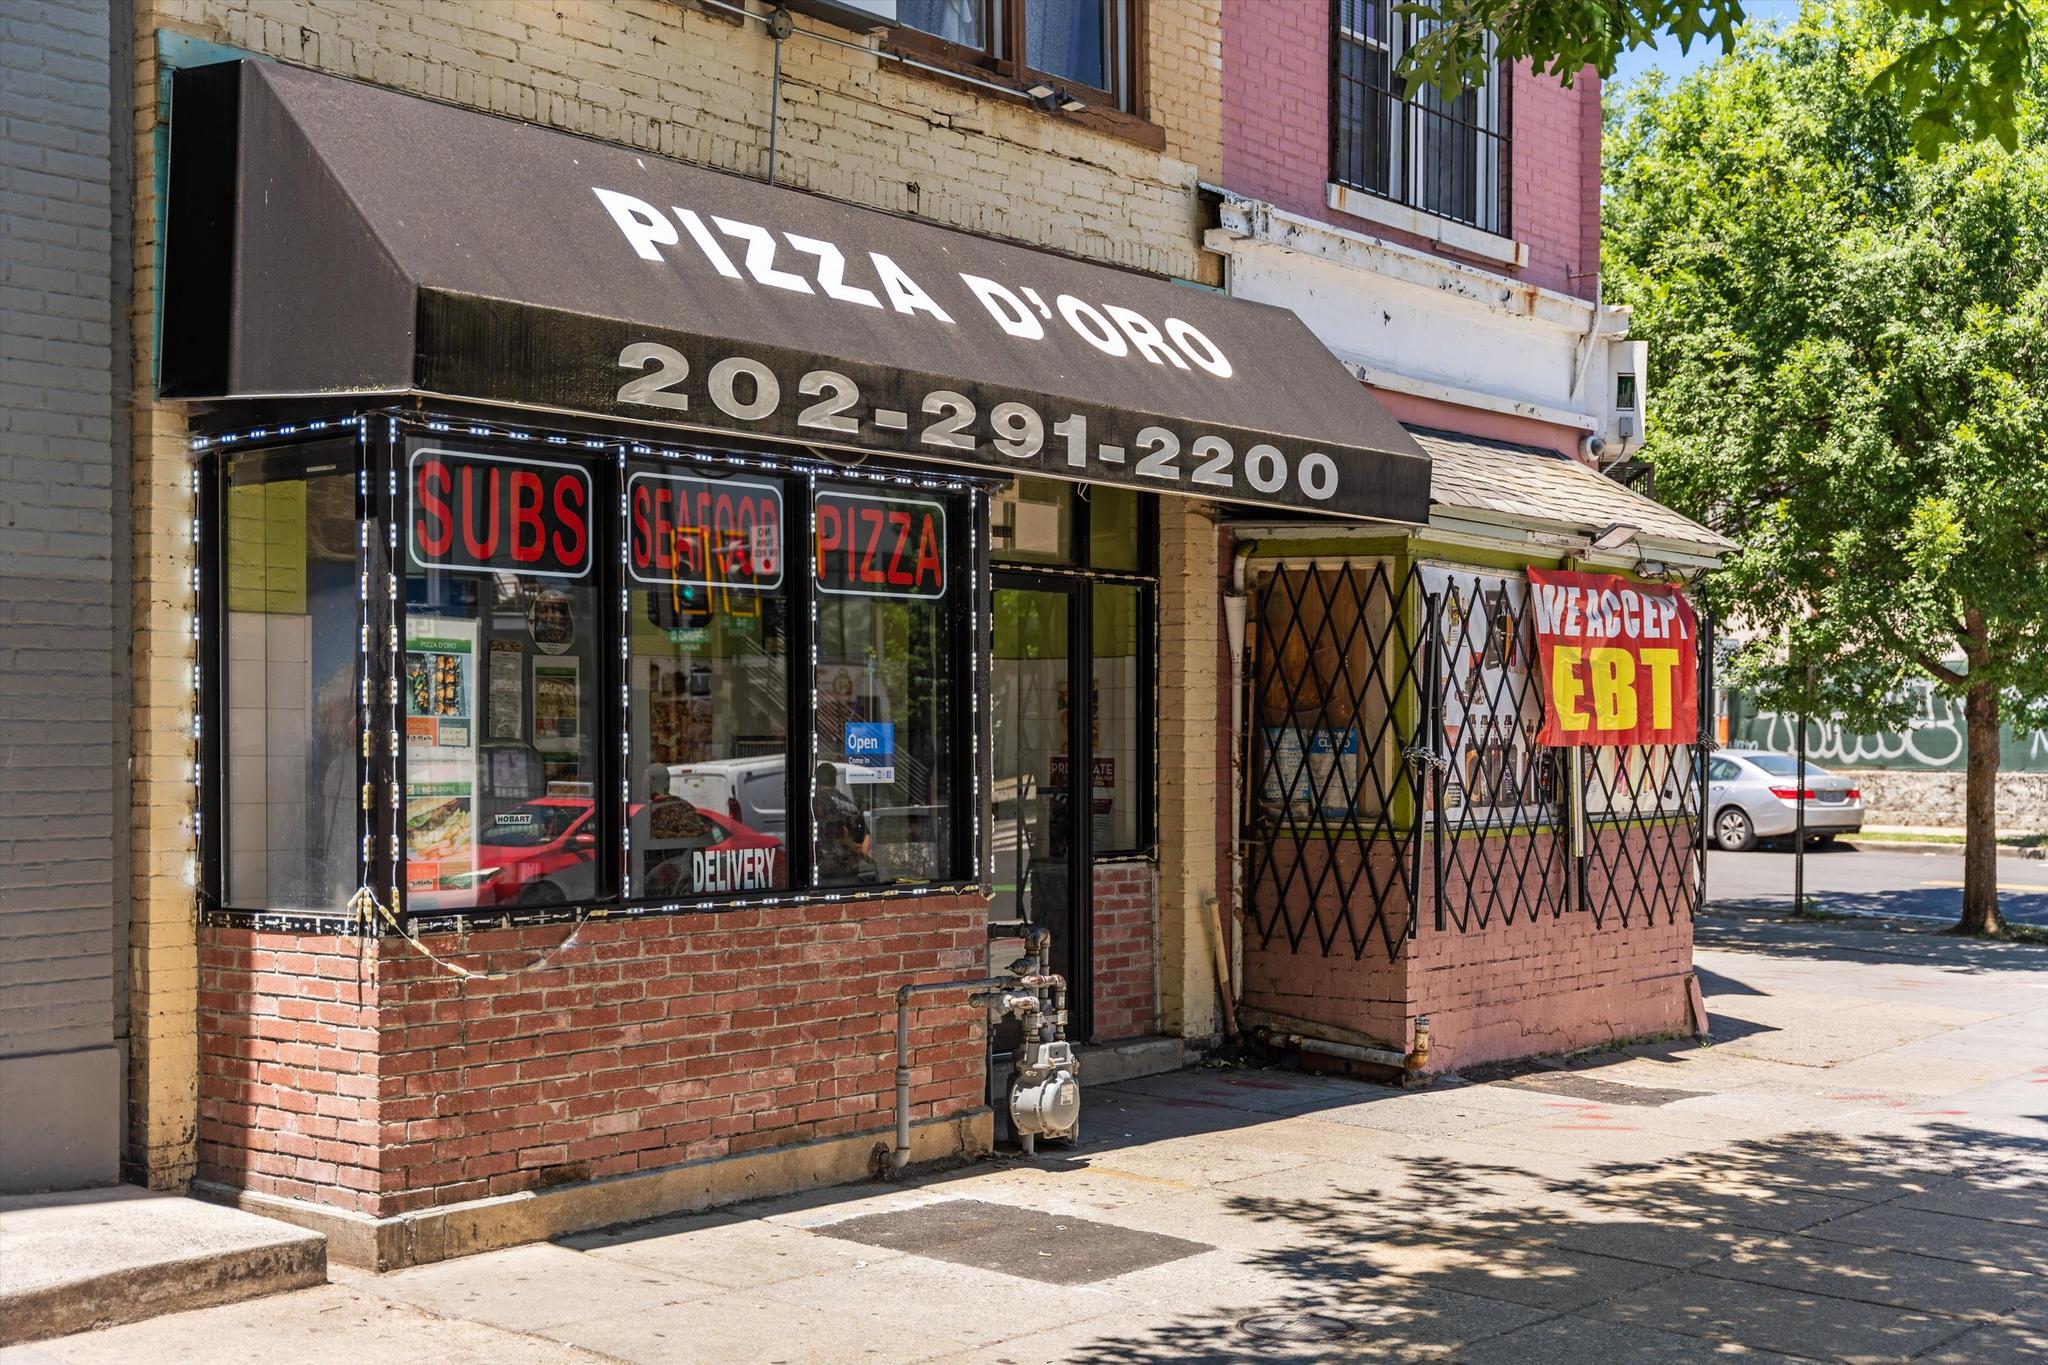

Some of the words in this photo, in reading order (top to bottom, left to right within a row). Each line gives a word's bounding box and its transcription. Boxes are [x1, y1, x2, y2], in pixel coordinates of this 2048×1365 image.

[592, 186, 957, 324] PIZZA
[958, 272, 1233, 379] D'ORO
[616, 341, 1340, 500] 202-291-2200
[416, 459, 588, 567] SUBS
[632, 484, 780, 577] SEAFOOD
[815, 502, 944, 588] PIZZA
[420, 640, 438, 649] PIZZA
[1530, 582, 1583, 638] WE
[1552, 644, 1680, 732] EBT
[847, 733, 878, 753] Open
[848, 756, 864, 765] Come
[497, 815, 531, 824] HOBART
[692, 846, 777, 894] DELIVERY
